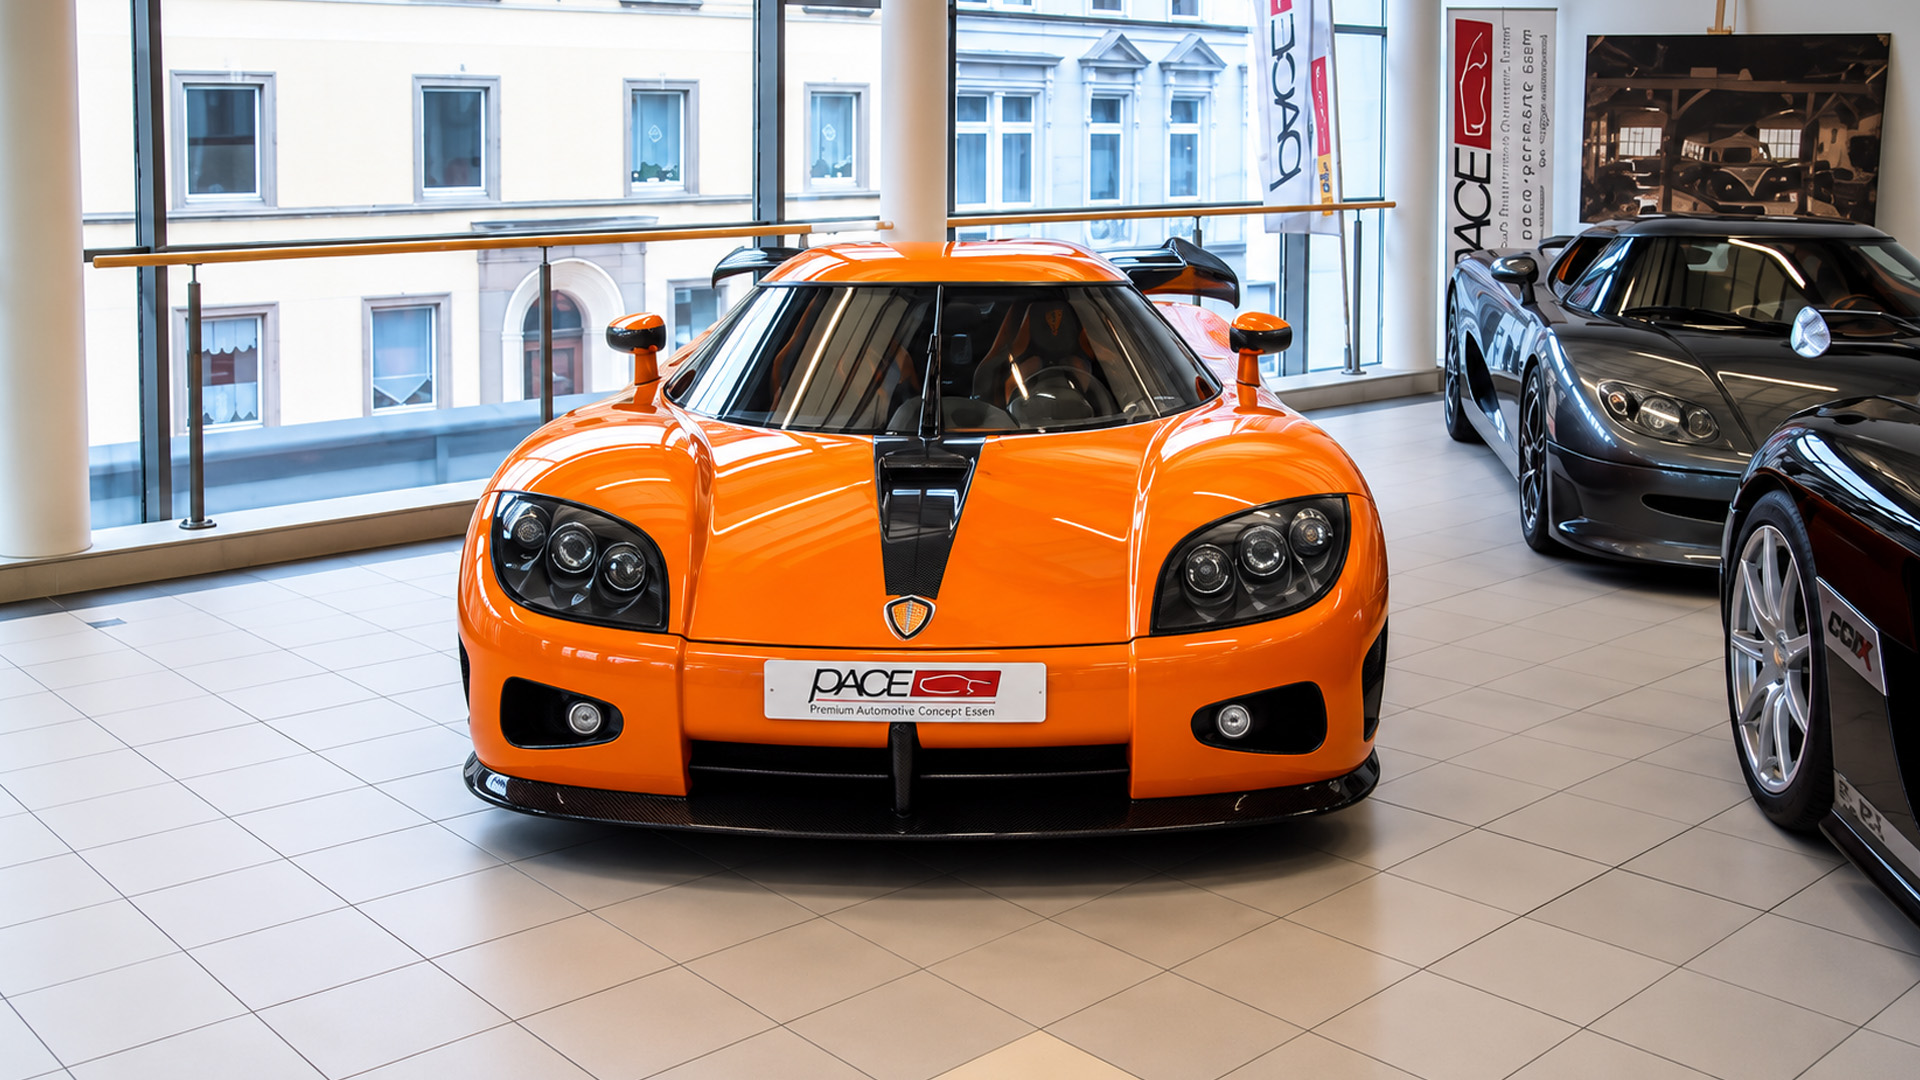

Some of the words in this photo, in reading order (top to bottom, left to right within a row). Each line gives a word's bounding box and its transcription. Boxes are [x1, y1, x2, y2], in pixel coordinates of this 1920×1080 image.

[807, 668, 913, 703] PACE
[809, 704, 854, 715] Premium
[856, 705, 915, 716] Automotive
[918, 706, 962, 718] Concept
[965, 706, 995, 717] Essen
